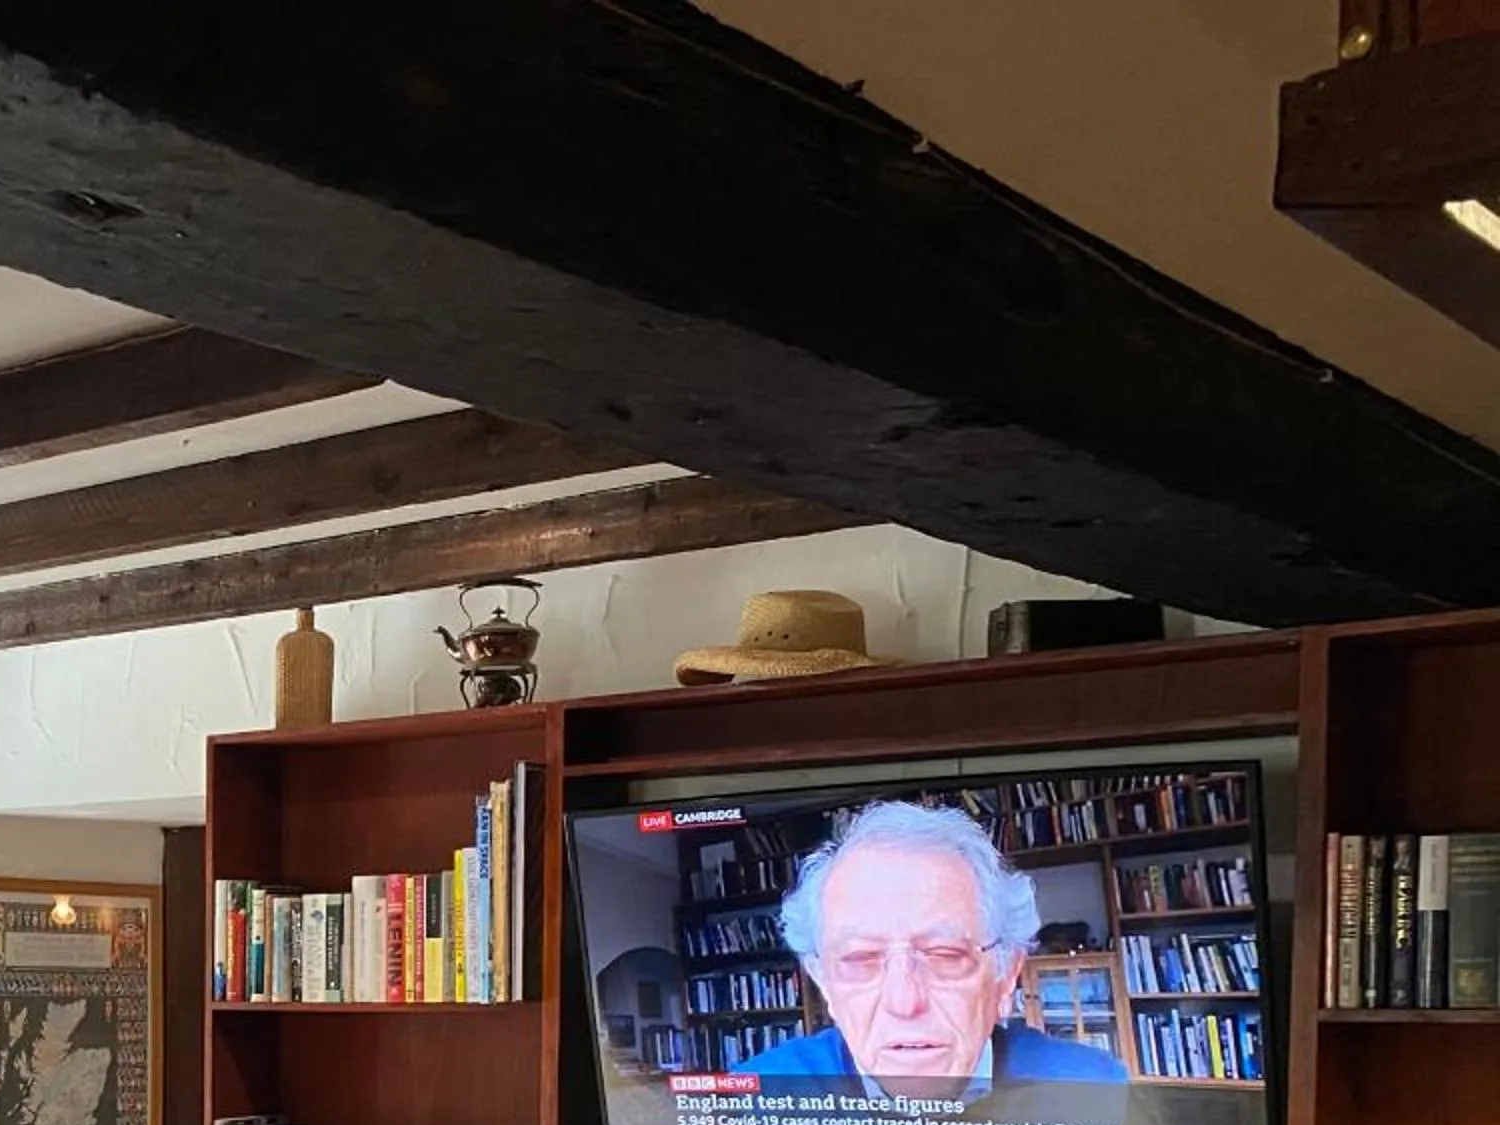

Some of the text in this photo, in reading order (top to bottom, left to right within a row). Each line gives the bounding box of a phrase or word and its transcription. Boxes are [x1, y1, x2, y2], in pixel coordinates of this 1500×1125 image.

[643, 808, 743, 827] LIVE CAMBRIDGE
[387, 915, 402, 987] LENIN
[672, 1076, 755, 1091] BBC NEWS
[676, 1094, 964, 1116] England test and trace figures
